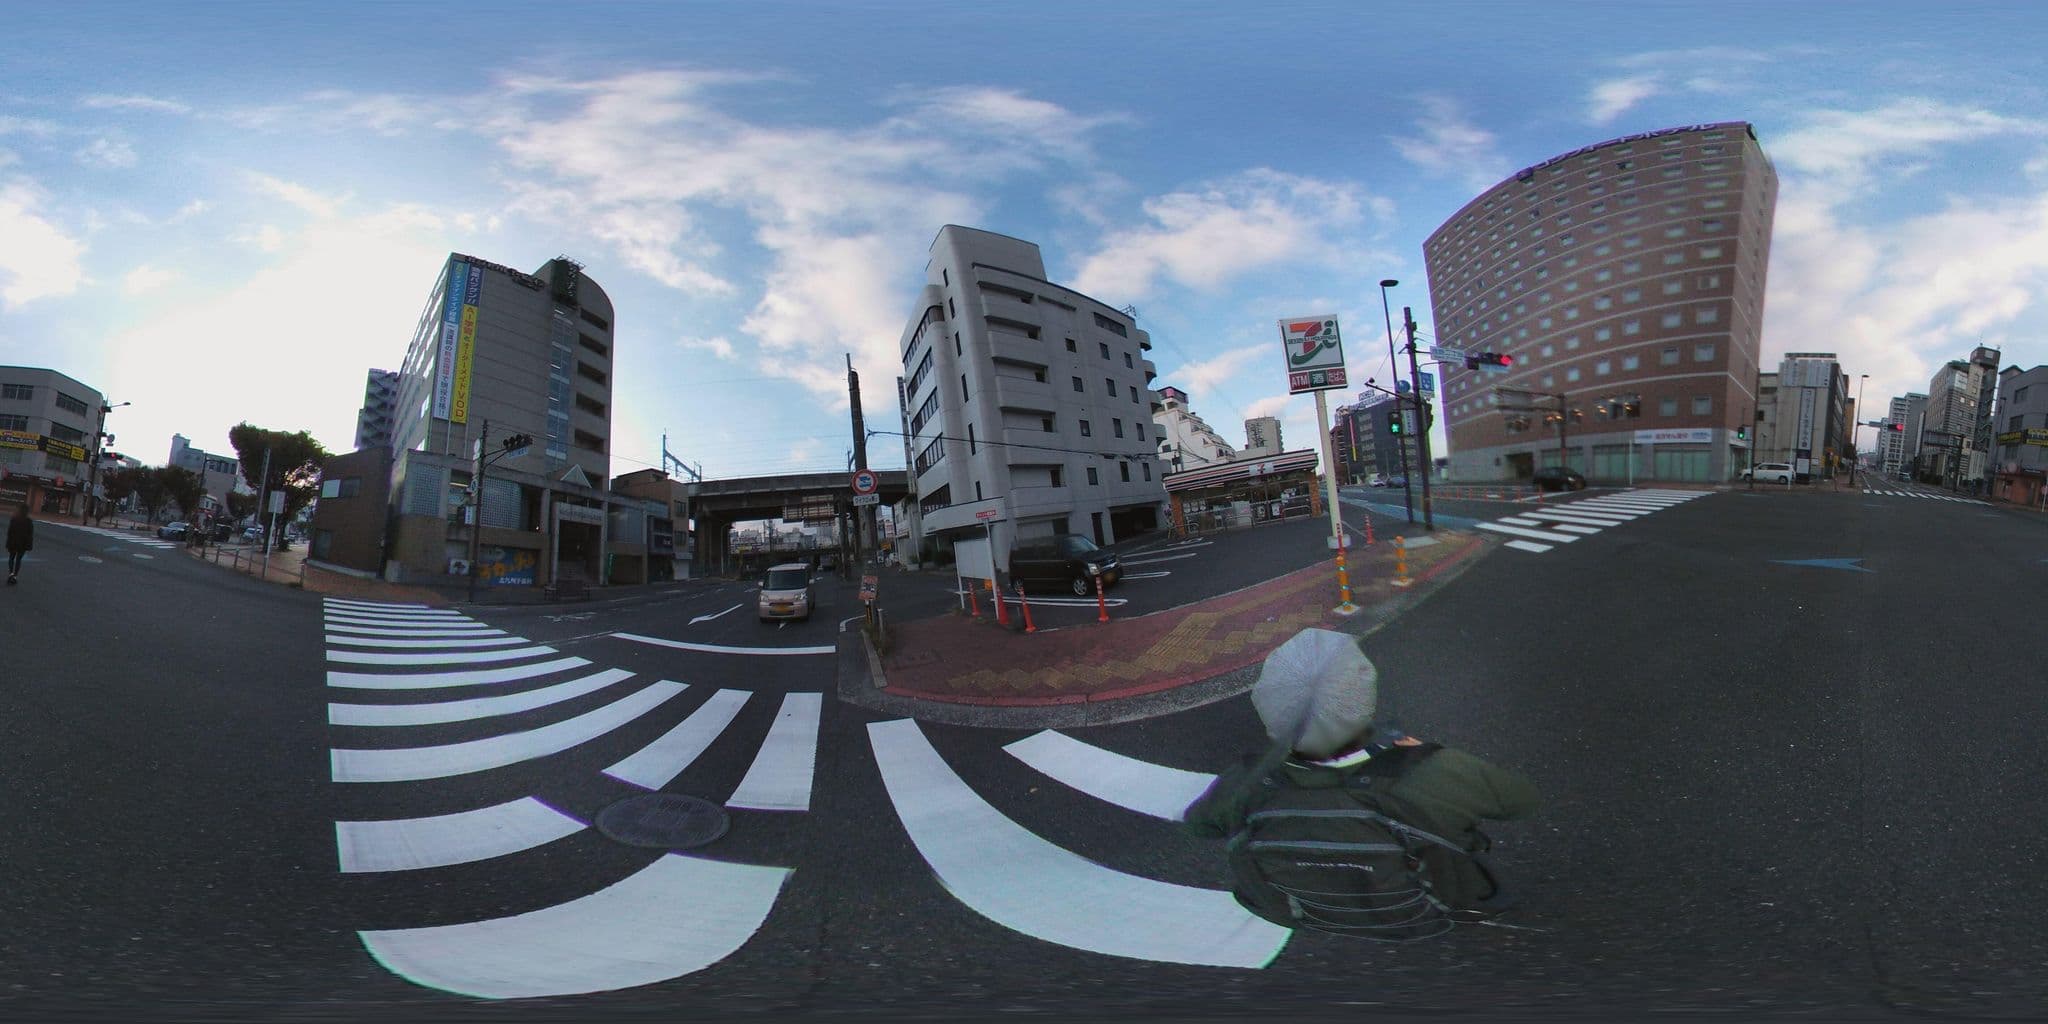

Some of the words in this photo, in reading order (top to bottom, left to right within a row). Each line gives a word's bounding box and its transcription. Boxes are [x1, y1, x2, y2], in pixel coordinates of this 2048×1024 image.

[1291, 374, 1308, 388] ATM
[1312, 373, 1324, 384] 酒
[1328, 371, 1345, 383] たばこ
